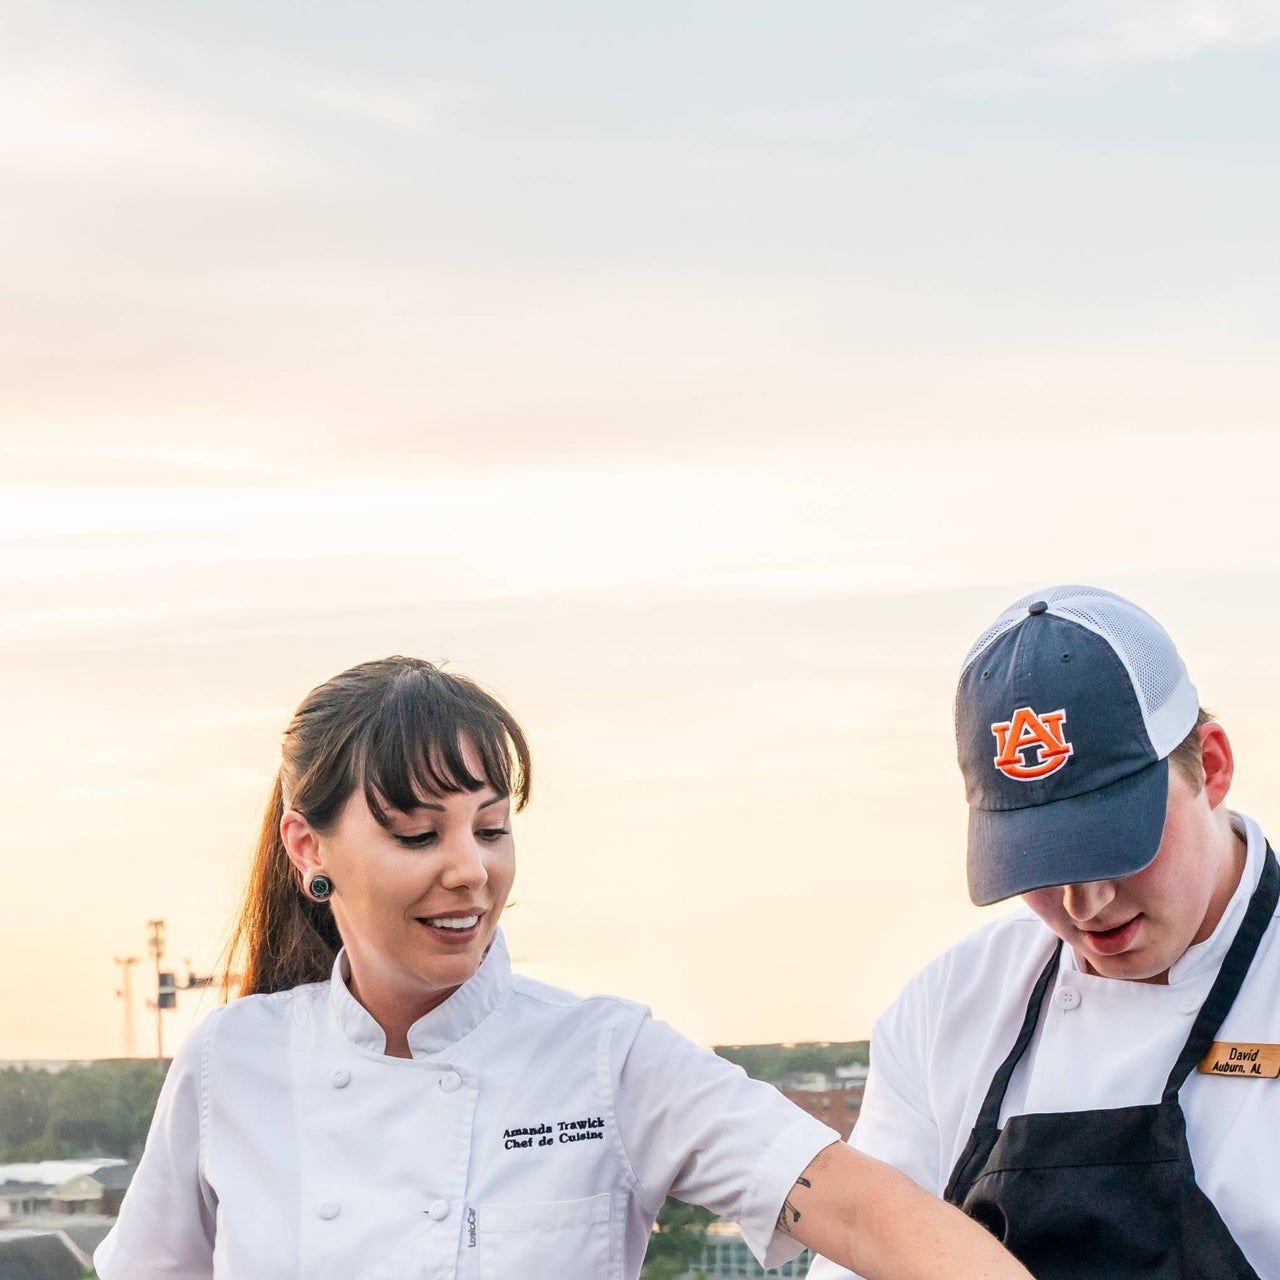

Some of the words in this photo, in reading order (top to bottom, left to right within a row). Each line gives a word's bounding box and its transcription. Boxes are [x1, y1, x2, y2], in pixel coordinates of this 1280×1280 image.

[1229, 1047, 1260, 1062] David
[1250, 1063, 1262, 1075] AL
[503, 1123, 553, 1139] Amanda
[557, 1116, 605, 1132] Trawick
[504, 1138, 533, 1150] Chef
[538, 1136, 554, 1147] de
[559, 1130, 604, 1144] Cuisine
